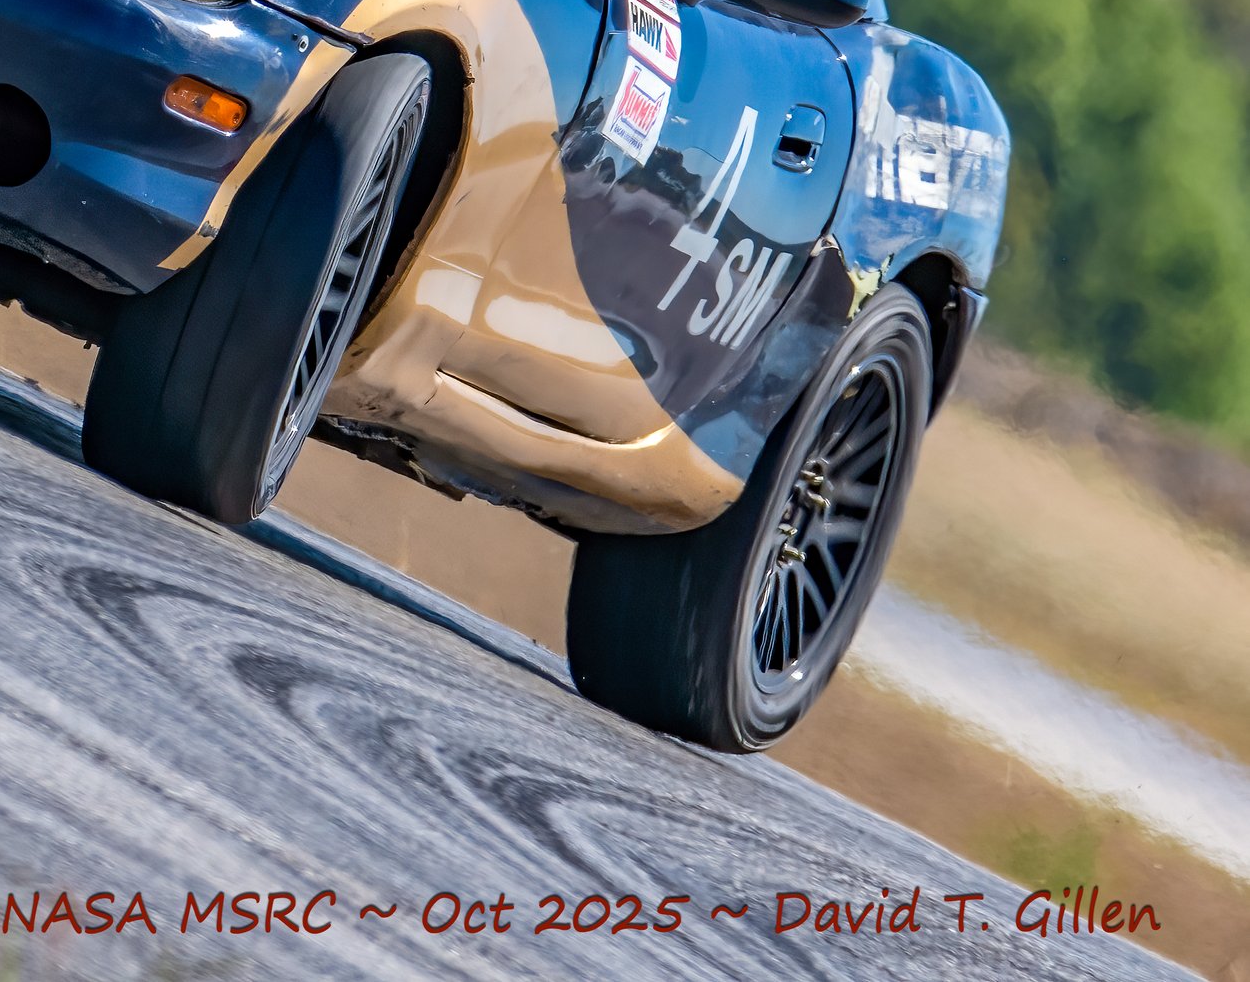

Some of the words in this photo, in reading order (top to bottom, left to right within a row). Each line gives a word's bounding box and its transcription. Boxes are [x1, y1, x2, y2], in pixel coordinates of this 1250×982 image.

[630, 2, 664, 53] HAWK
[657, 106, 758, 311] 4
[687, 237, 792, 351] SM
